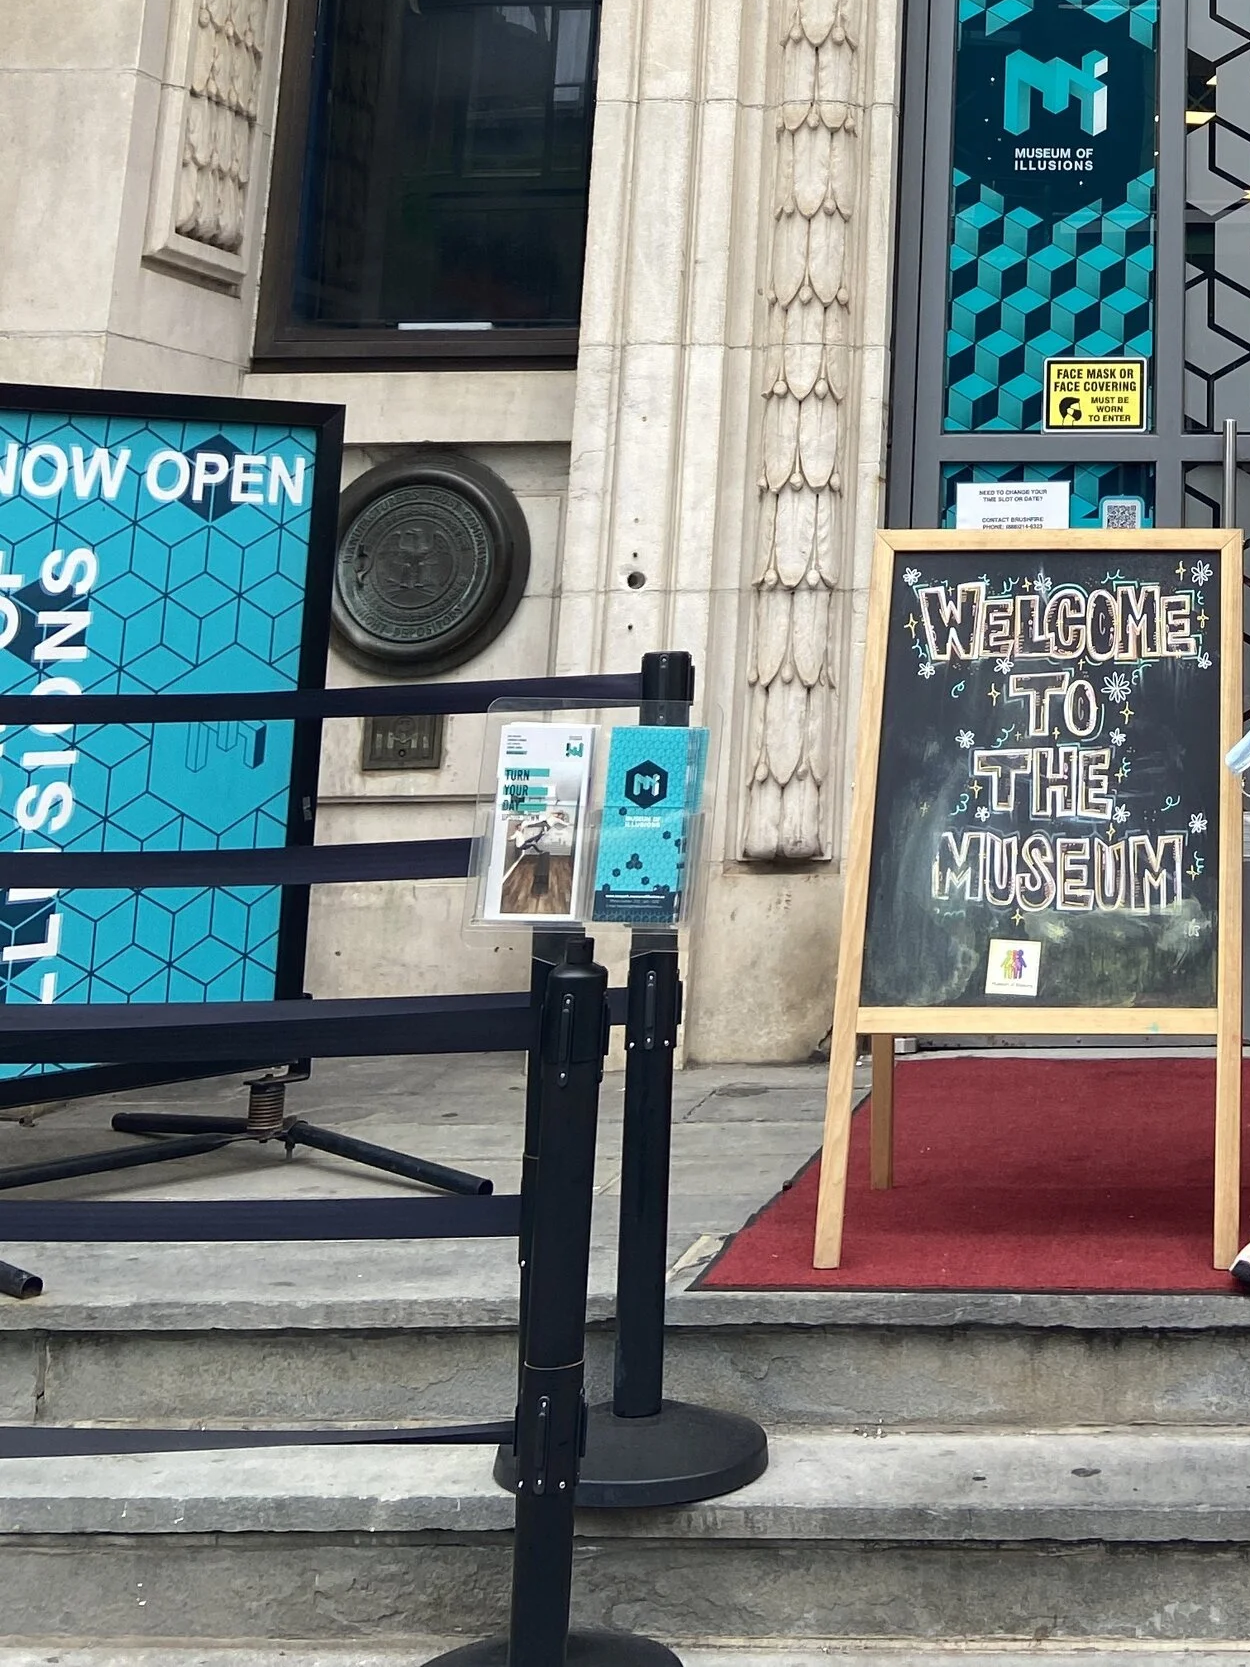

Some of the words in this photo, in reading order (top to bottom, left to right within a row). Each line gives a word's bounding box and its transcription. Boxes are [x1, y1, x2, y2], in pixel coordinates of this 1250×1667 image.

[1014, 148, 1071, 159] MUSEUM
[1076, 148, 1094, 159] OF
[1014, 160, 1094, 171] ILLUSIONS
[1056, 369, 1083, 380] FACE
[1086, 368, 1117, 379] MASK
[1119, 368, 1134, 379] OR
[1053, 382, 1080, 392] FACE
[1083, 381, 1137, 392] COVERING
[145, 449, 306, 505] OPEN
[918, 581, 1200, 662] WELCOME
[1008, 672, 1099, 737] TO
[505, 769, 530, 781] TURN
[2, 548, 97, 1024] LSINS
[973, 745, 1116, 821] THE
[504, 784, 529, 796] YOUR
[502, 799, 520, 811] DAY
[931, 832, 1185, 914] MUSEUM
